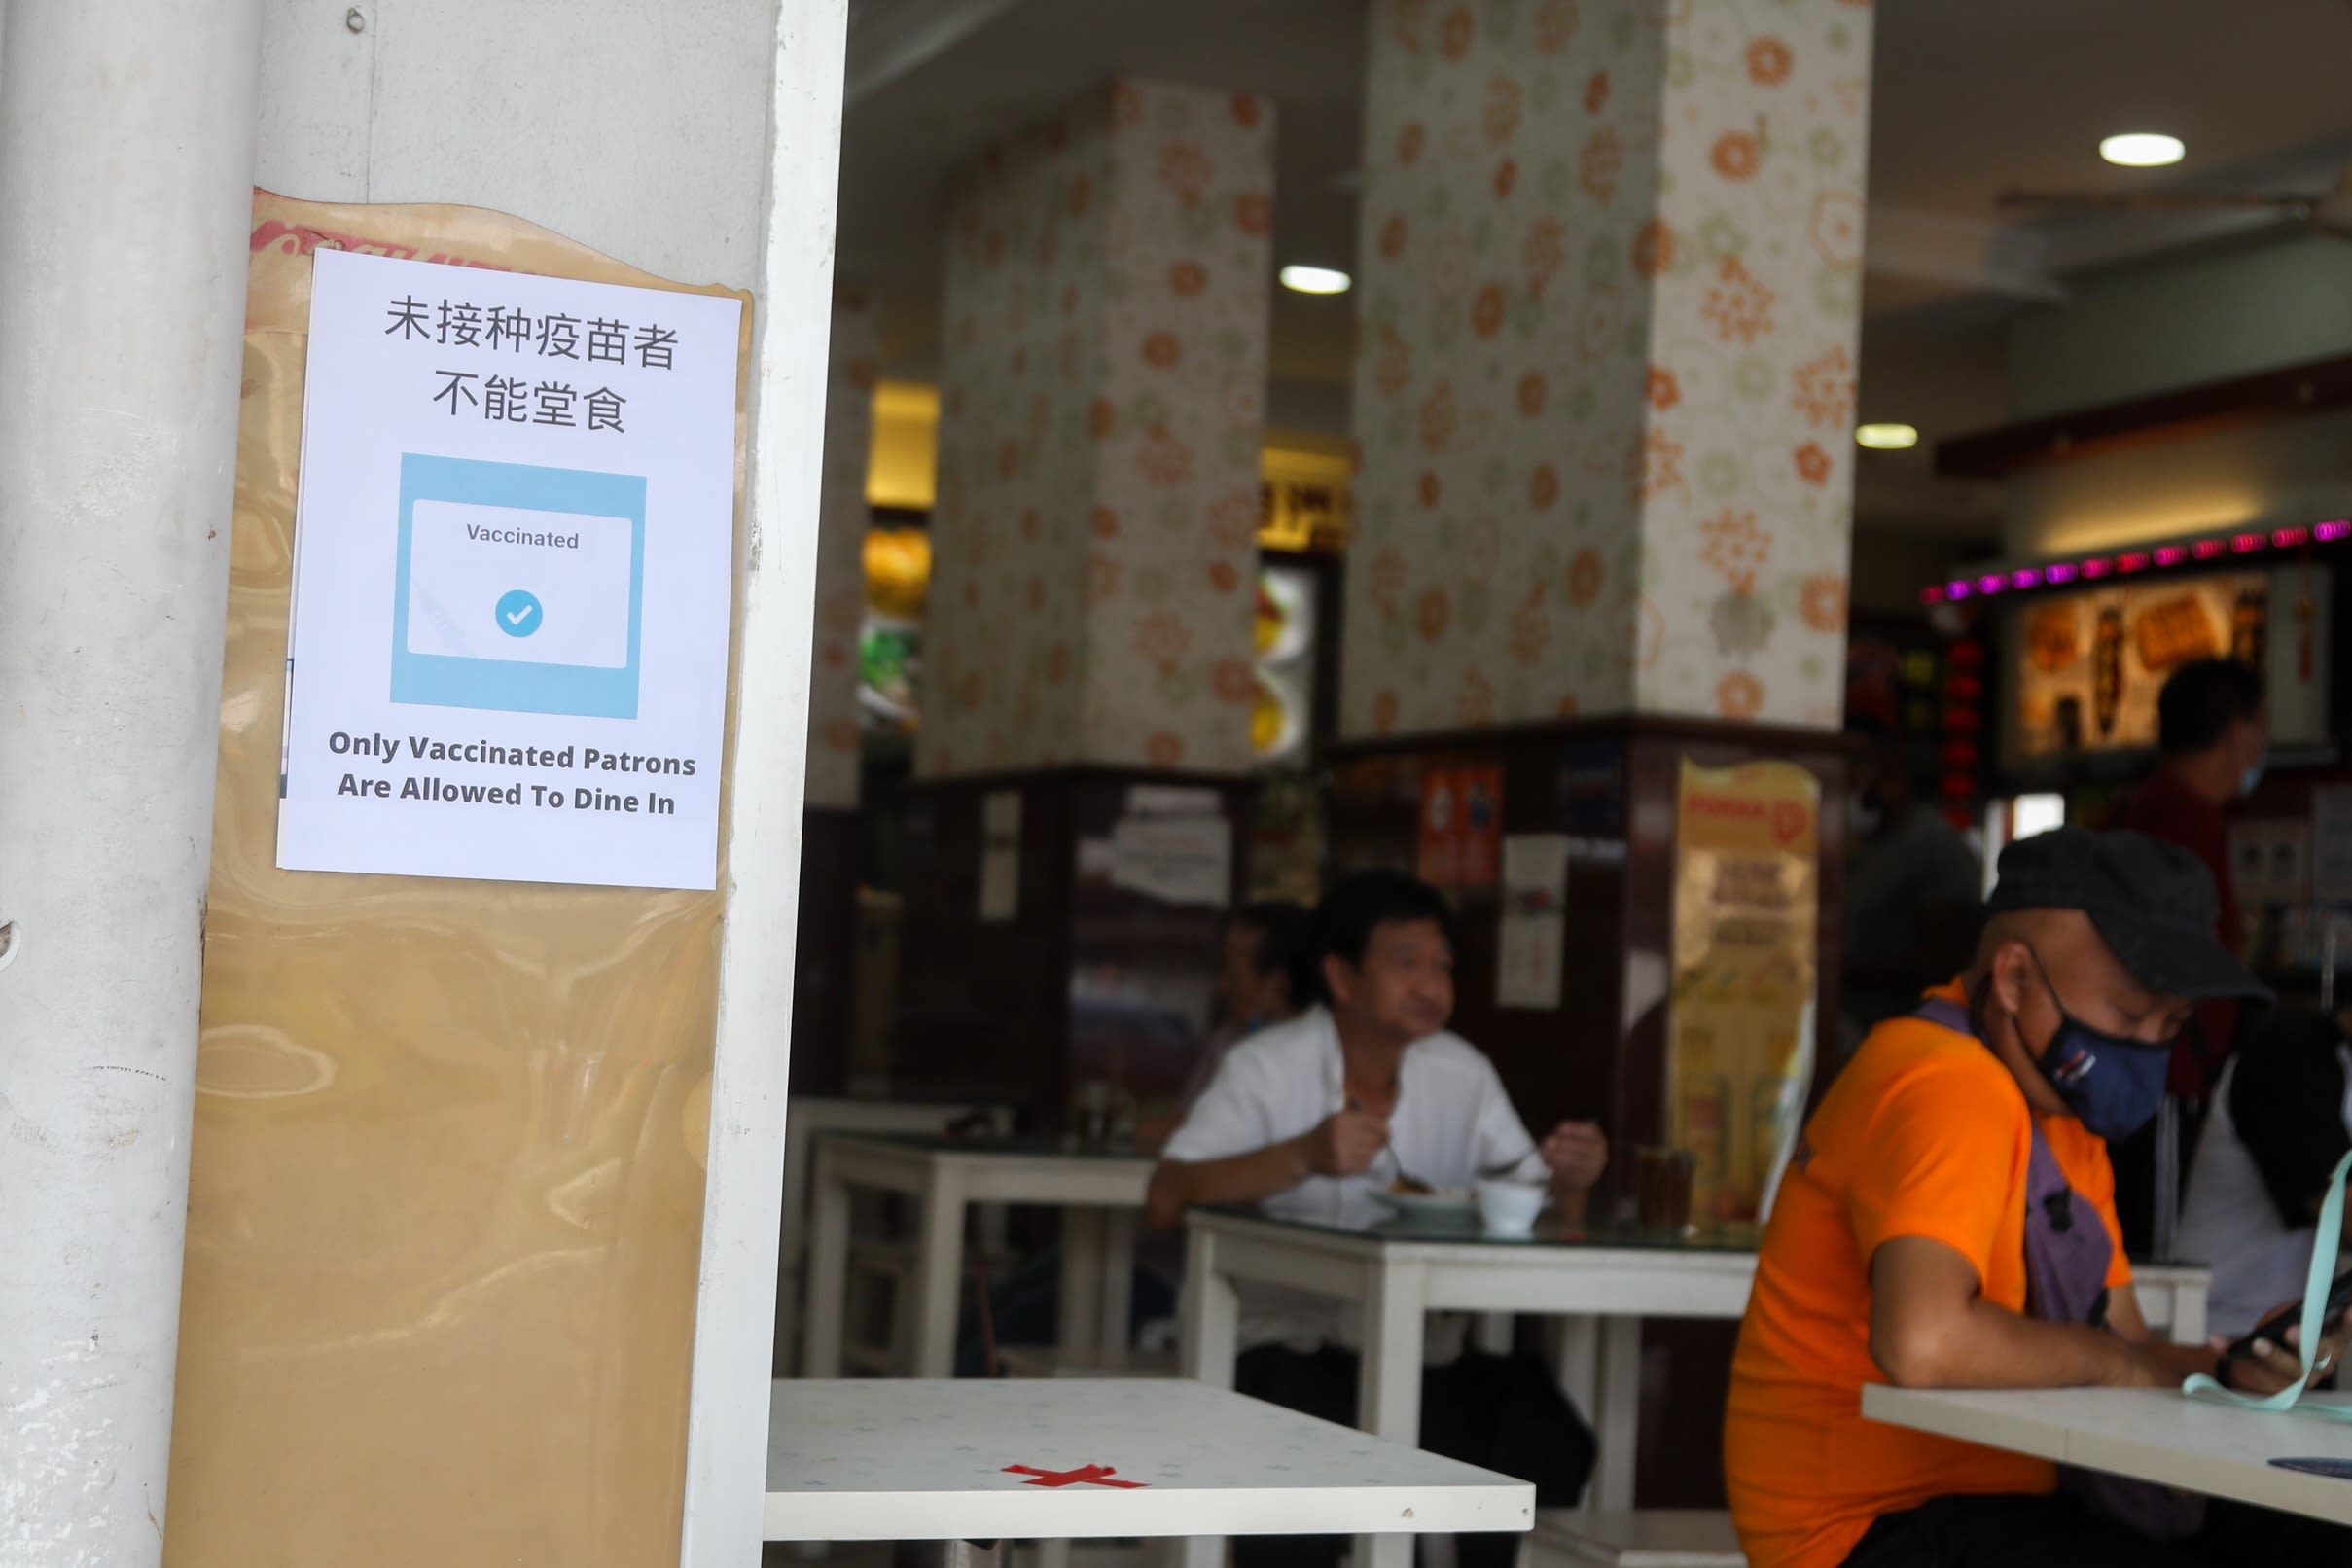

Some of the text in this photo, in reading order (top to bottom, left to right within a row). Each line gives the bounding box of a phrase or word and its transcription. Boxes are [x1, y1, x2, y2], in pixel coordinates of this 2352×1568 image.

[384, 294, 679, 371] 未接种疫苗者
[432, 369, 627, 434] 不能堂食
[466, 523, 579, 550] Vaccinated
[329, 731, 697, 776] Only Vaccinated Patrons
[337, 773, 675, 815] Are Allowed To Dine In
